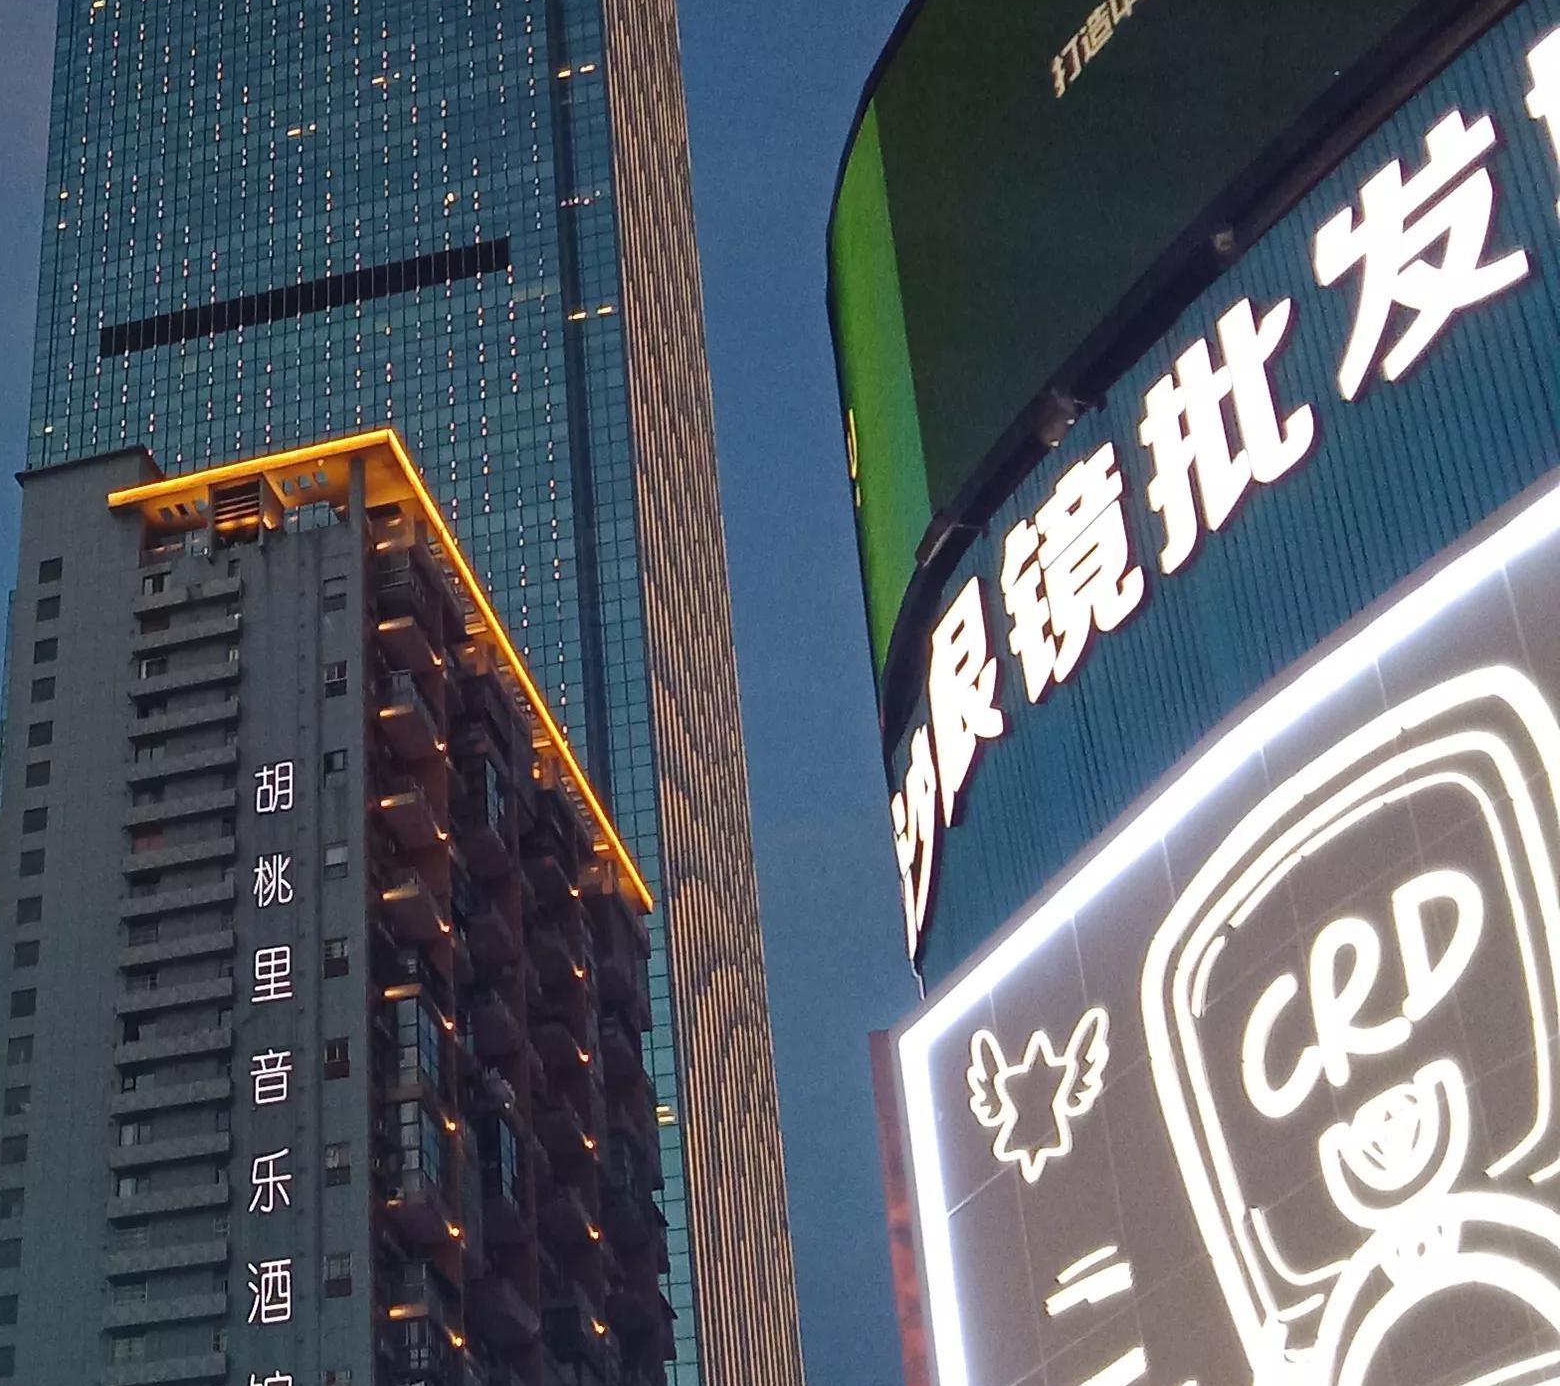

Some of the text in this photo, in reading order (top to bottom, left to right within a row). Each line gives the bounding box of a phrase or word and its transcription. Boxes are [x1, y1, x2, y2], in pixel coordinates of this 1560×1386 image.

[890, 23, 1560, 961] 沙眼镜批发
[1242, 870, 1484, 1118] CRD
